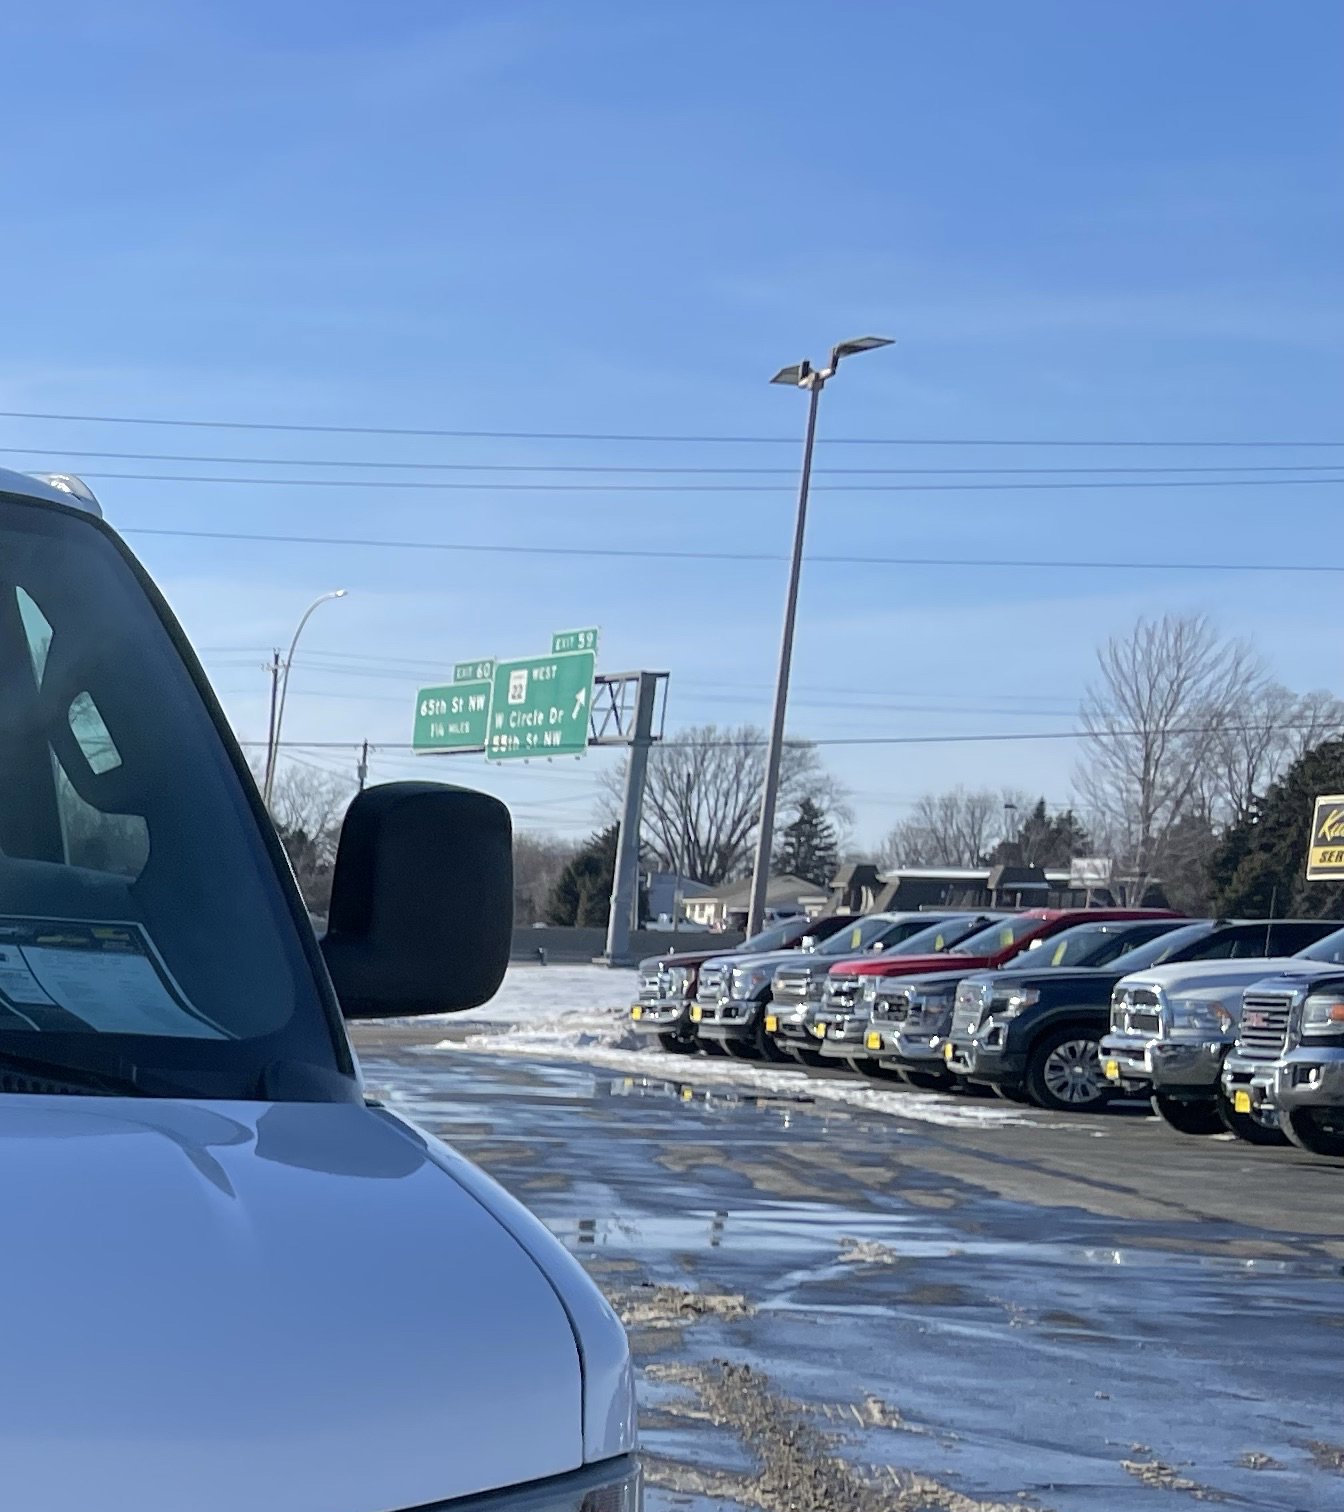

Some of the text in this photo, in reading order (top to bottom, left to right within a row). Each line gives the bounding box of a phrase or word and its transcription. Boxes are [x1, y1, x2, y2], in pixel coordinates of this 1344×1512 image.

[555, 636, 574, 651] EXIT
[456, 662, 491, 679] EXIT 60
[532, 665, 557, 680] WEST
[512, 684, 523, 700] 22
[420, 694, 486, 717] 65th St NW
[495, 706, 564, 729] W Circle Dr
[526, 732, 539, 750] St
[543, 730, 562, 747] NW
